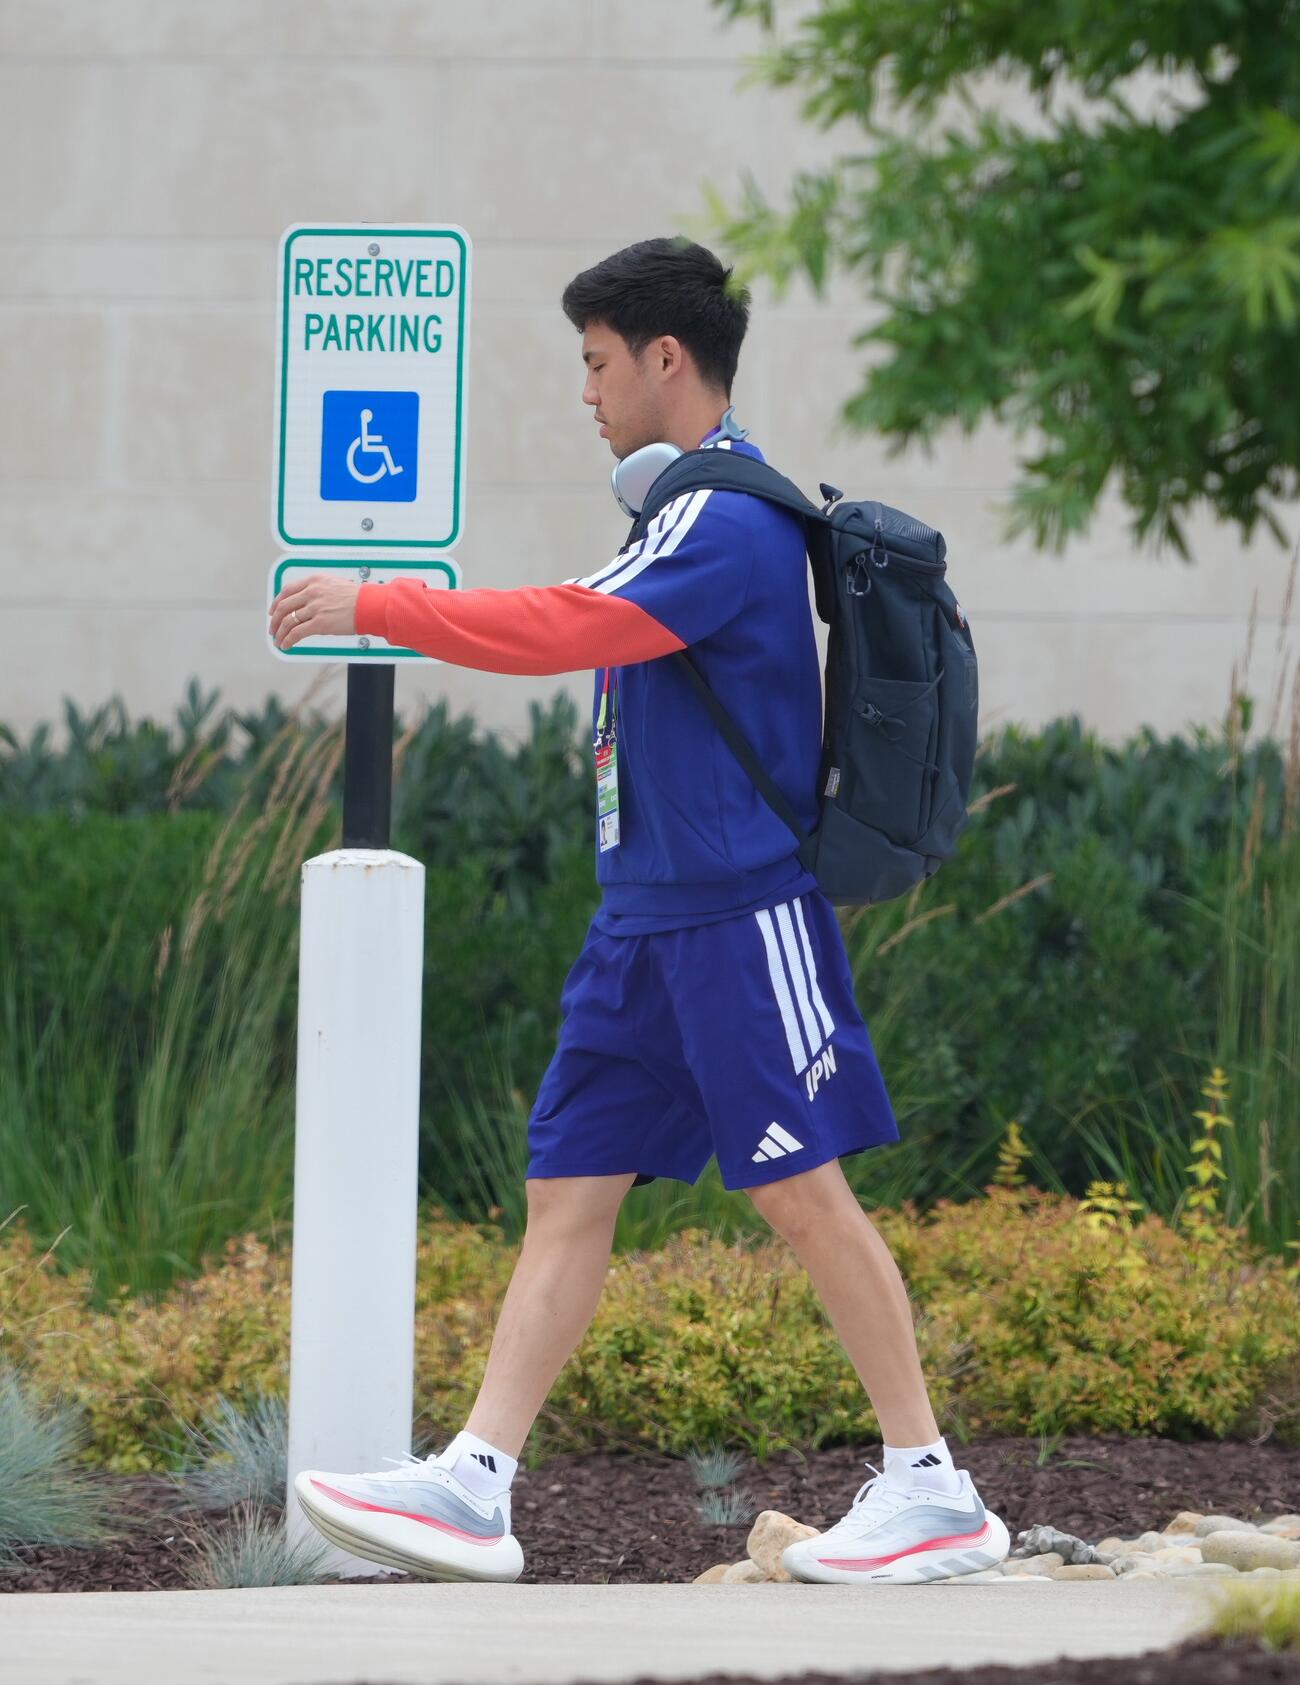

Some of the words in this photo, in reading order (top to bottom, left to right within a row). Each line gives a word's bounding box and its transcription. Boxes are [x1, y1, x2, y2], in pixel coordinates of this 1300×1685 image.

[294, 257, 455, 298] RESERVED
[304, 313, 443, 353] PARKING
[805, 1044, 837, 1102] JPN
